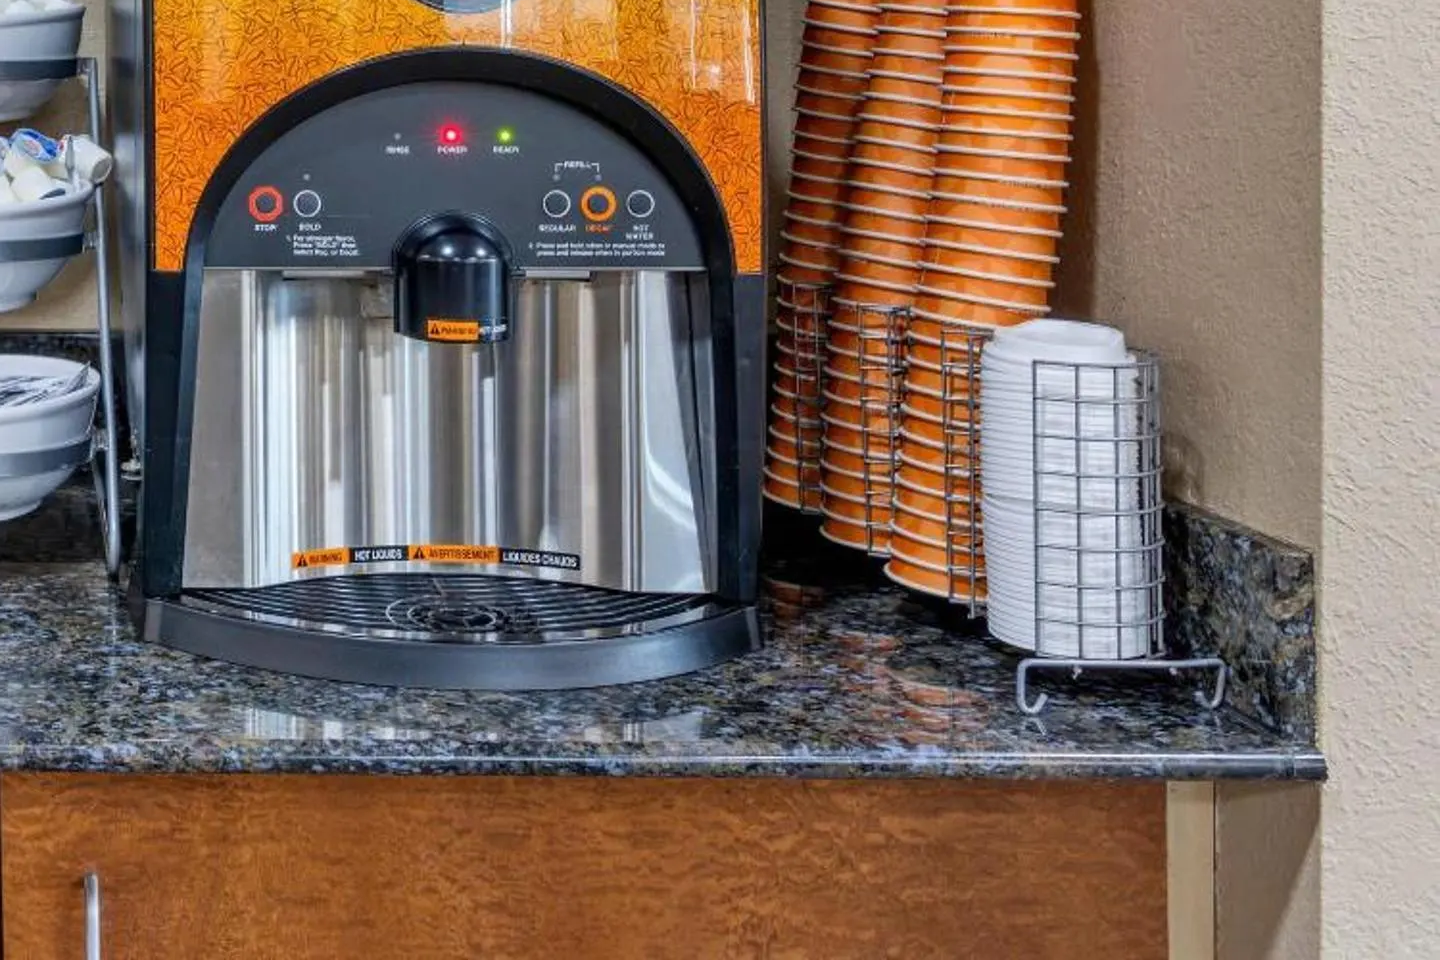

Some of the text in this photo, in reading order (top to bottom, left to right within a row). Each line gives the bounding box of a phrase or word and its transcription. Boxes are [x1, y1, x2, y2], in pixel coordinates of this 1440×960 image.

[437, 145, 468, 154] POWER
[492, 145, 520, 154] READY
[254, 224, 278, 232] STOP
[298, 223, 322, 232] BOLD
[538, 224, 577, 232] REGULAR
[625, 232, 654, 240] WATER
[354, 549, 371, 561] HOT
[371, 548, 403, 560] LIQUIDS
[428, 548, 496, 560] AVERTISSEMENT
[502, 550, 541, 564] LIQUIDES
[542, 554, 578, 568] CHAUDS
